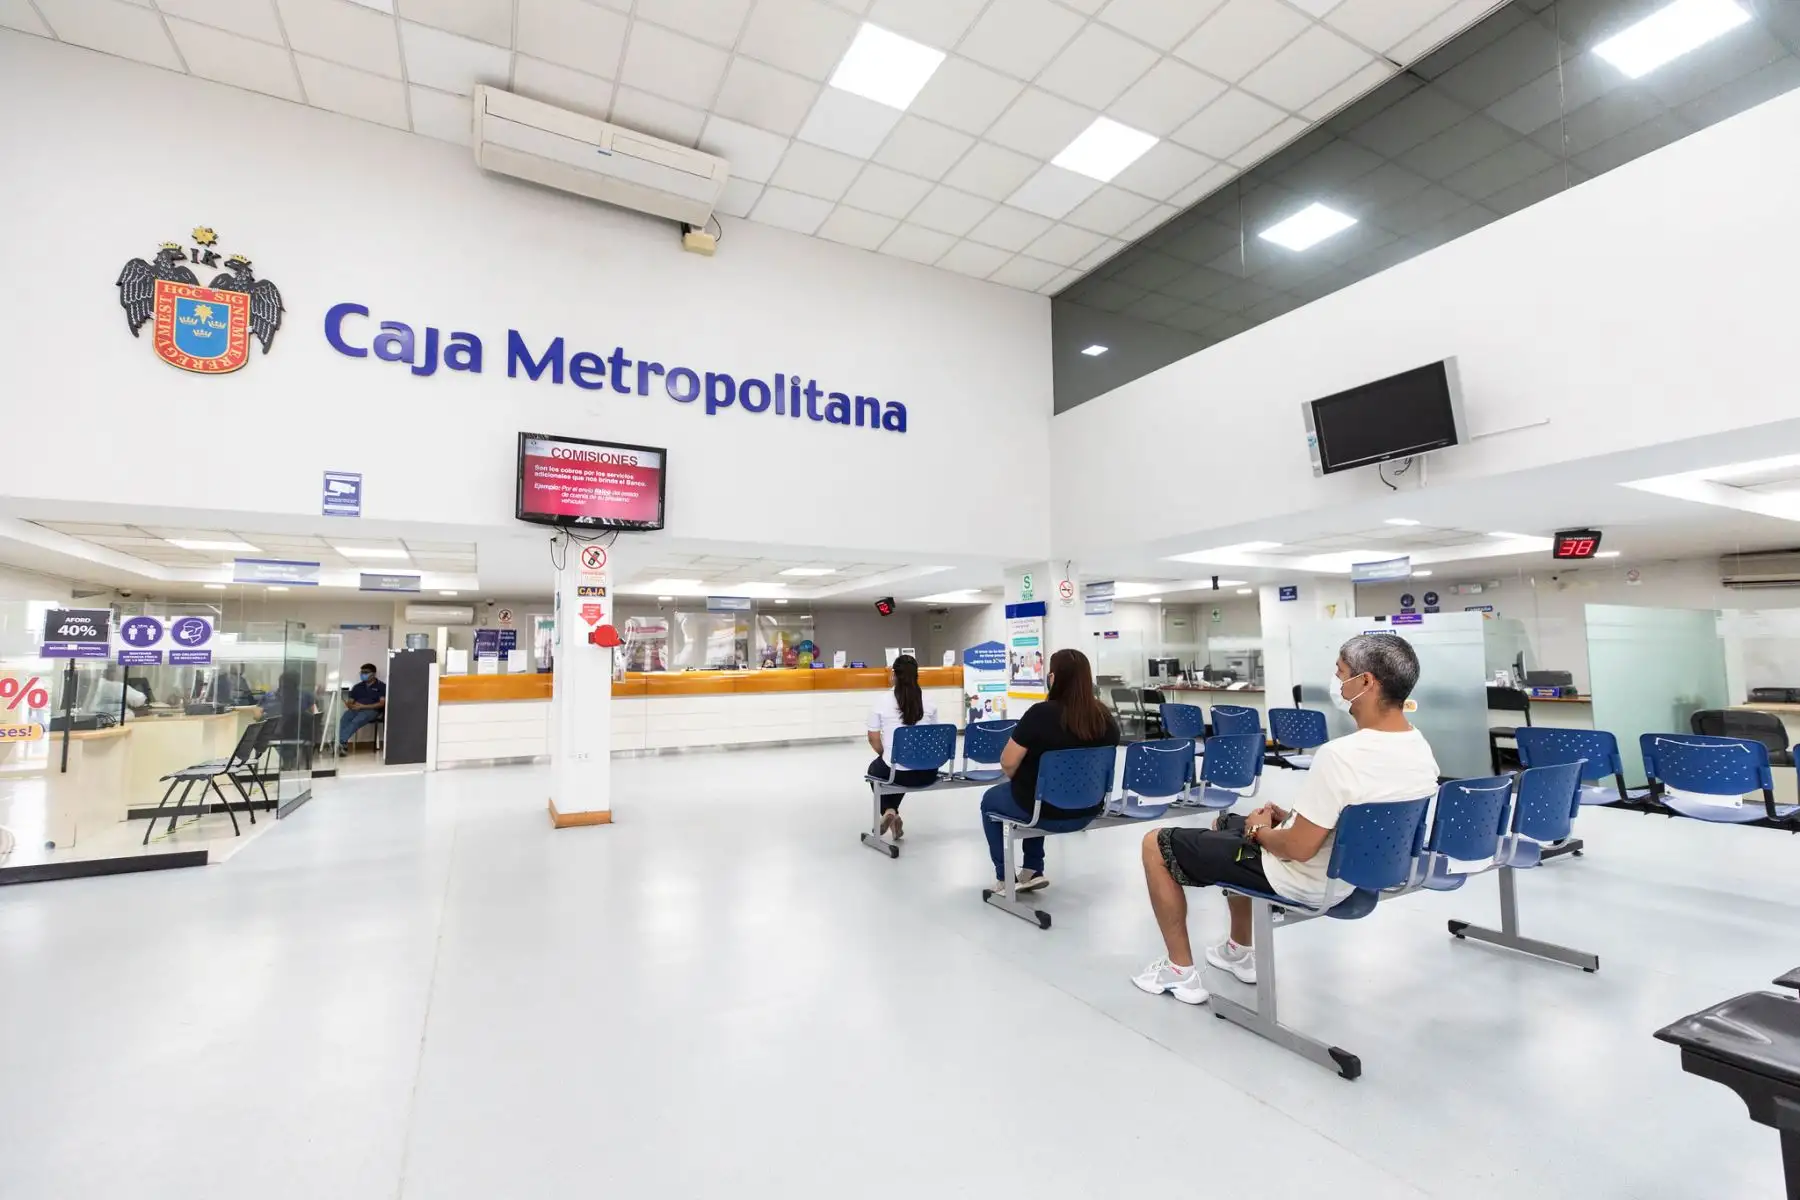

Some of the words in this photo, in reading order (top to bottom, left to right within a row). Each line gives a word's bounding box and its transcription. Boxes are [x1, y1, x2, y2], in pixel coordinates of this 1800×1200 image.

[164, 284, 203, 298] HOC
[324, 302, 483, 376] Caja
[508, 329, 907, 433] Metropolitana
[551, 447, 638, 466] COMISIONES
[584, 469, 595, 477] por
[606, 472, 634, 480] servicios
[1558, 540, 1594, 556] 38
[1024, 576, 1031, 590] S
[578, 588, 604, 596] CAJA
[57, 624, 97, 636] 40%
